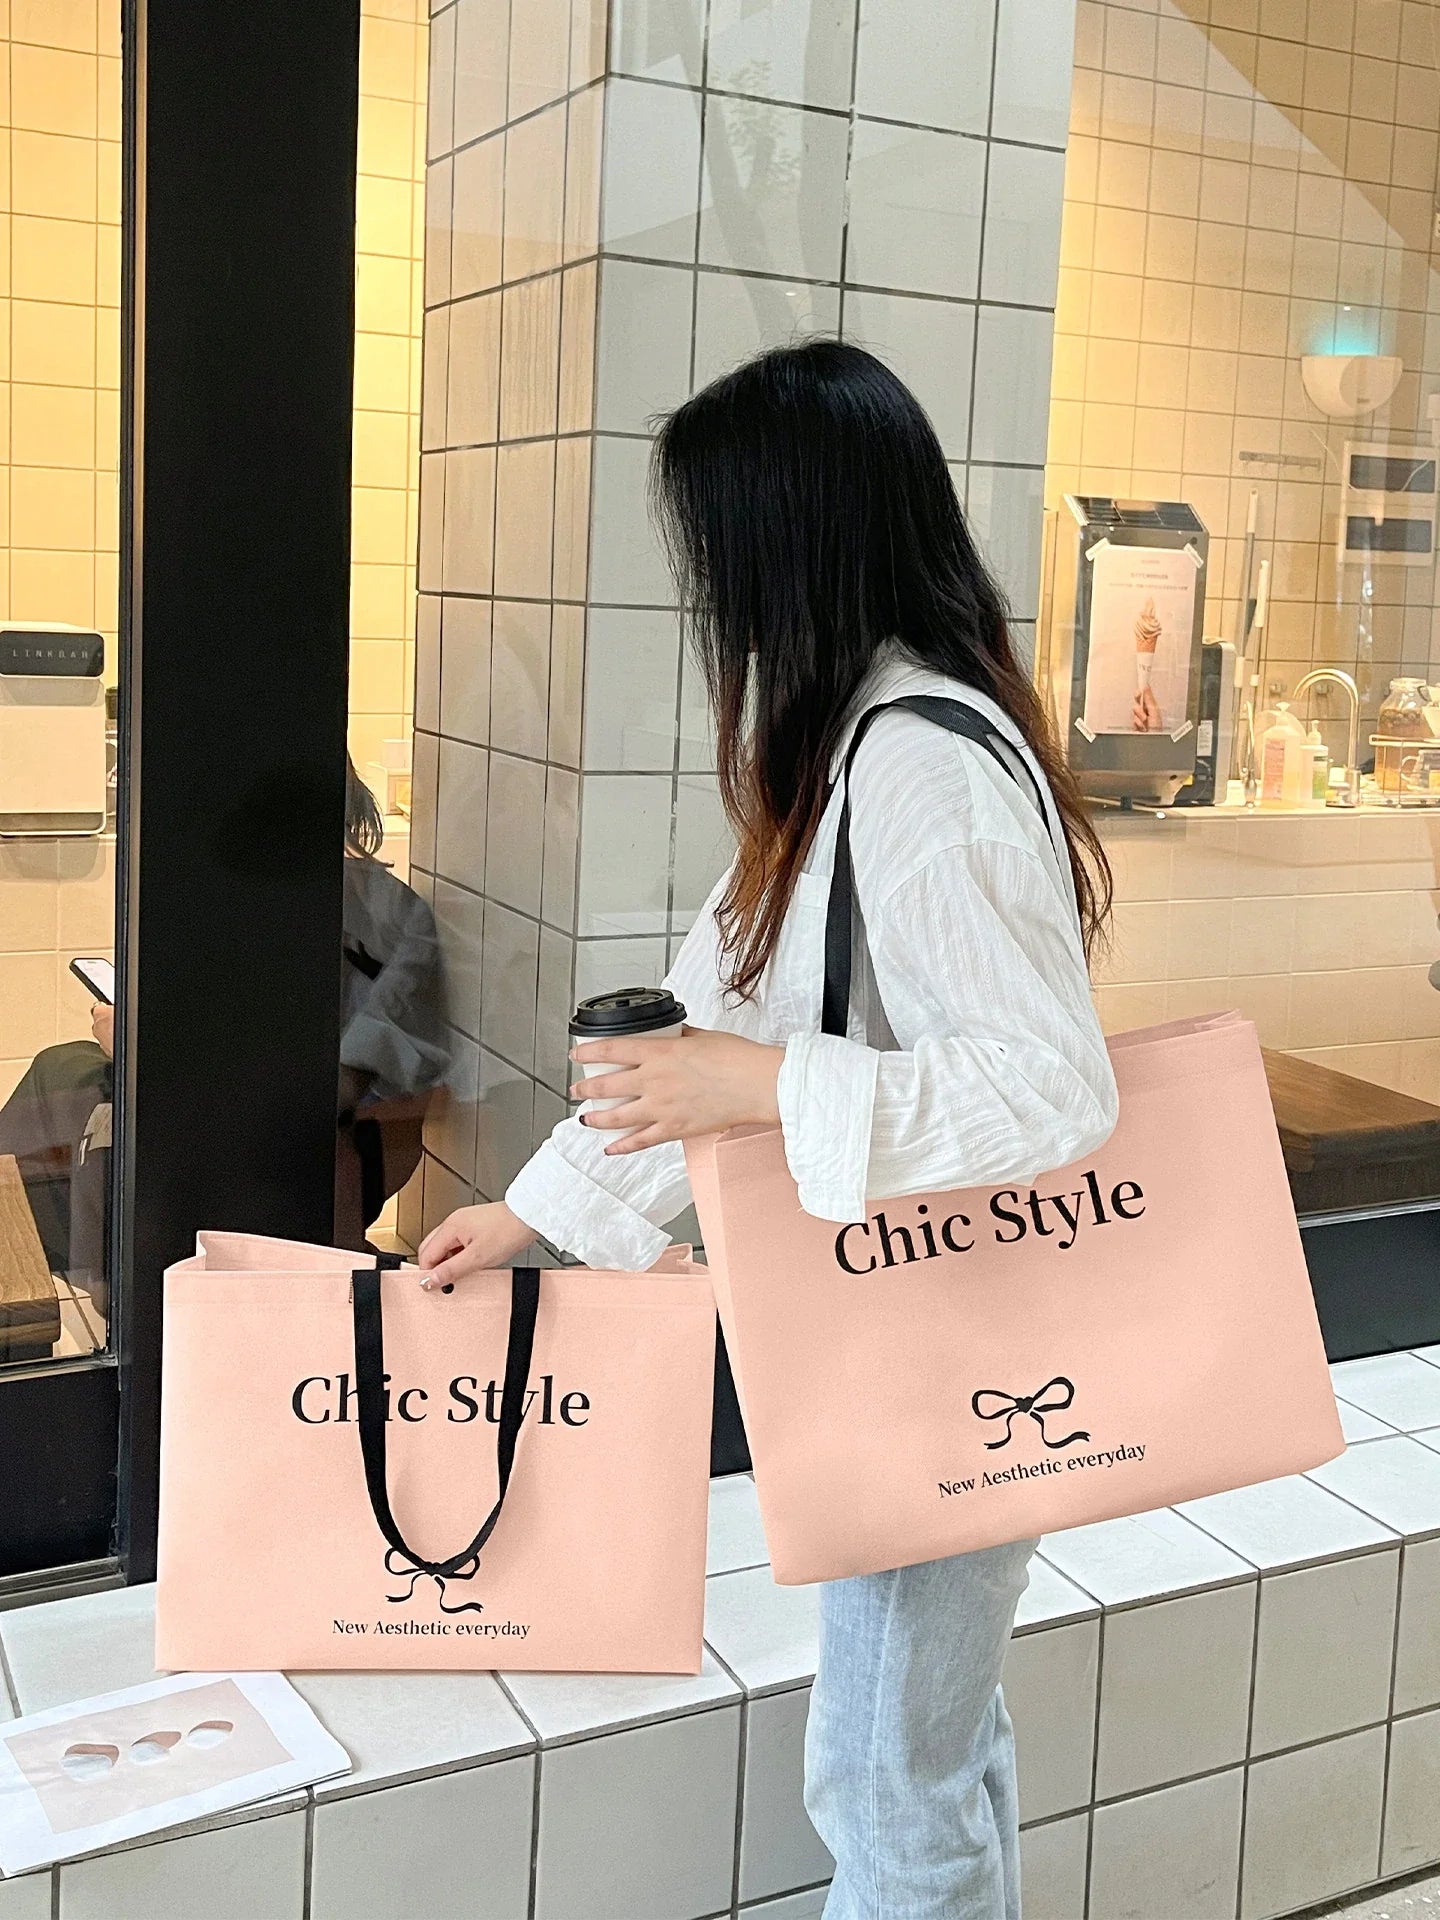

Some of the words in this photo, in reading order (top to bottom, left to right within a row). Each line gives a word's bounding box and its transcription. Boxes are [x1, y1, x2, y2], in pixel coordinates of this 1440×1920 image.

[834, 1203, 976, 1275] Chic
[989, 1170, 1147, 1250] Style
[936, 1477, 976, 1499] New
[981, 1458, 1063, 1489] Aesthetic
[1067, 1444, 1147, 1470] everyday
[332, 1619, 369, 1635] New
[373, 1619, 452, 1636] Aesthetic
[455, 1620, 532, 1640] everyday
